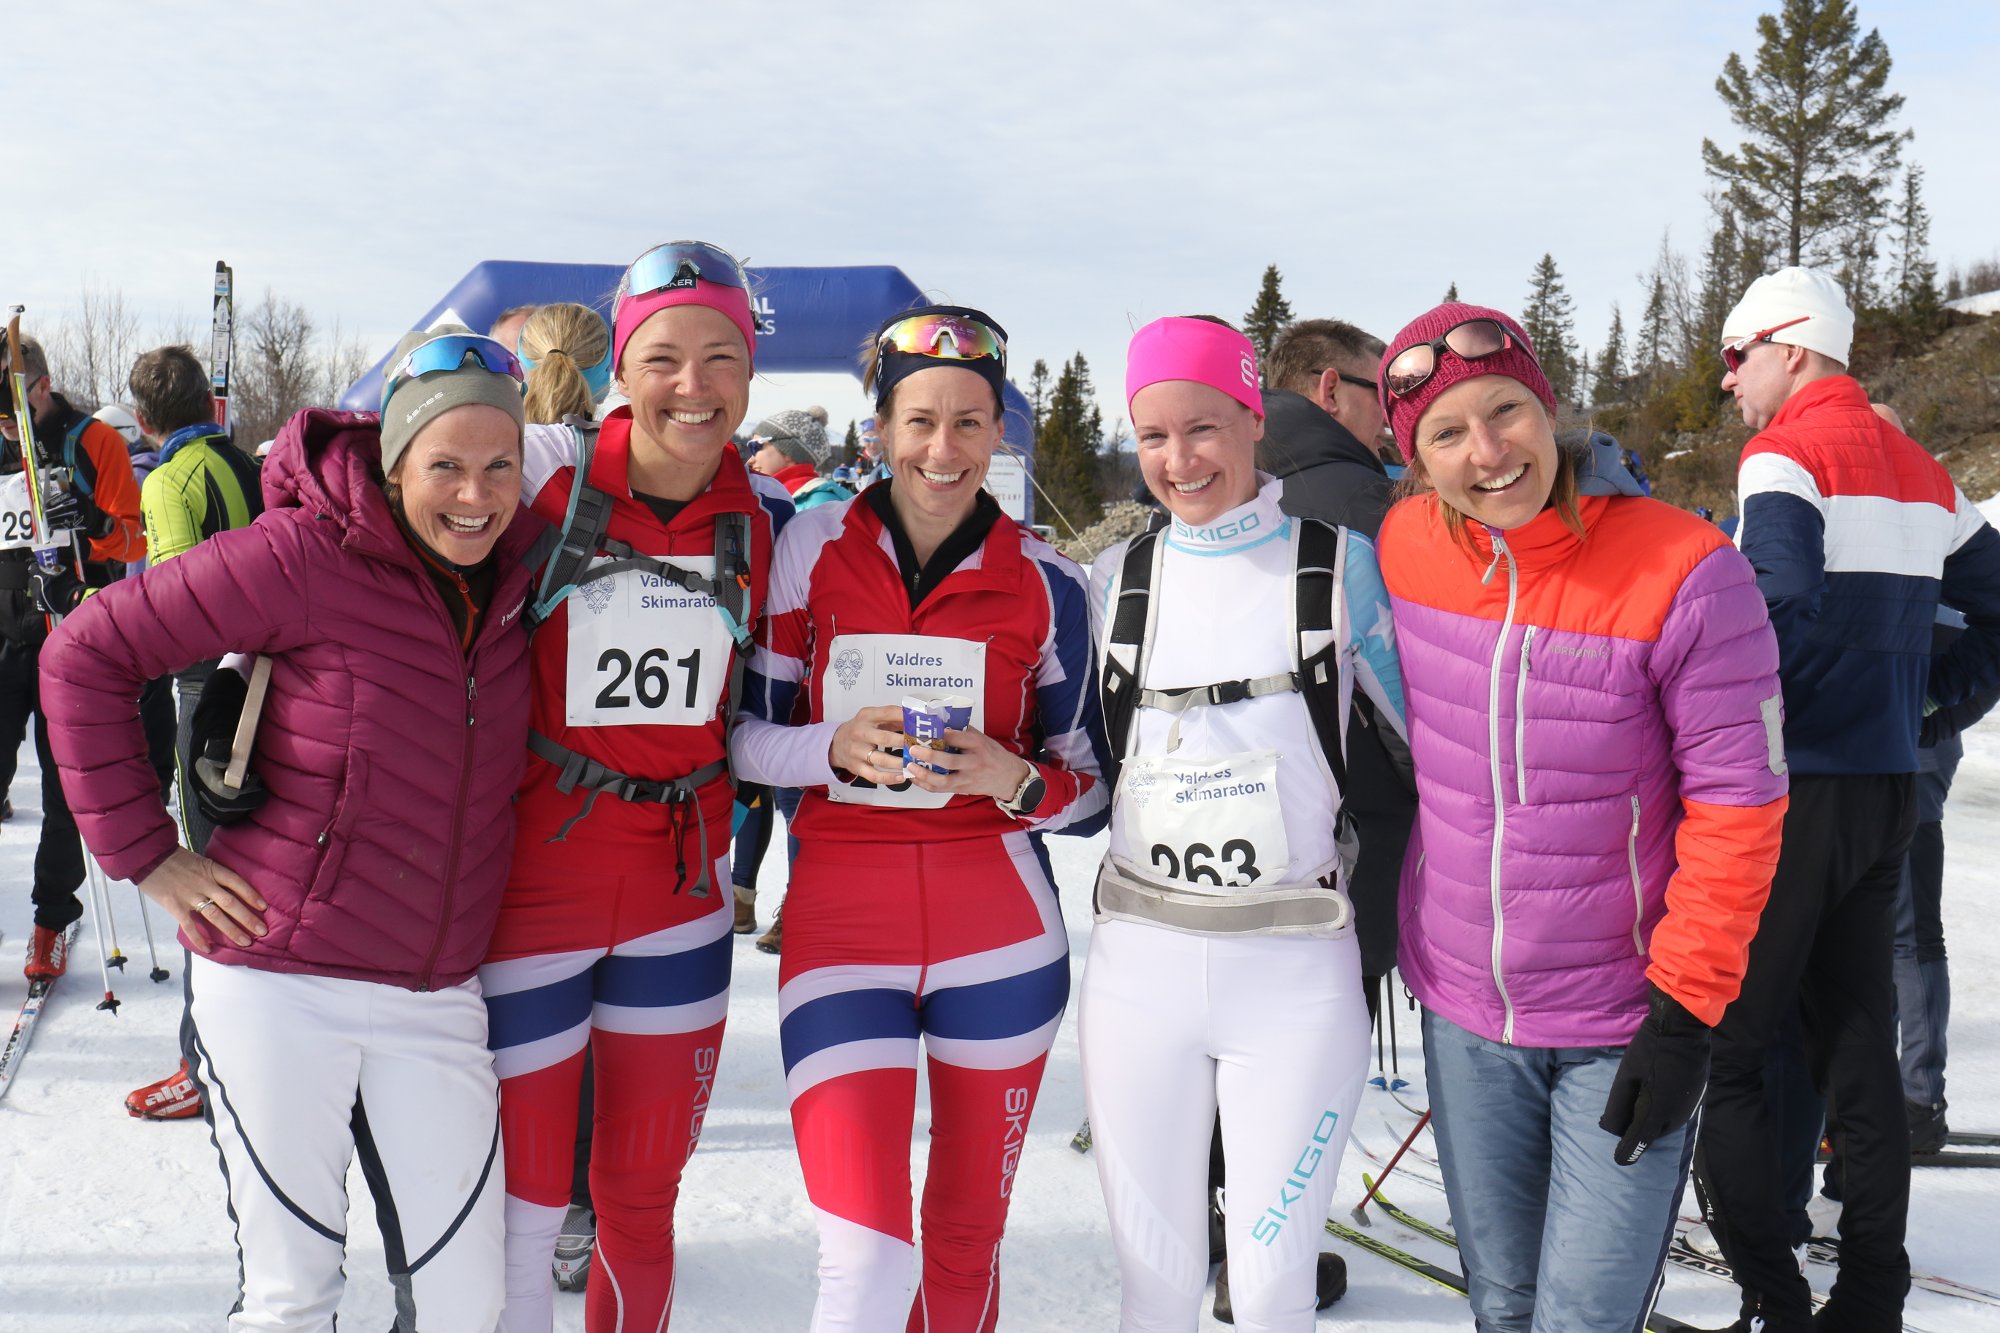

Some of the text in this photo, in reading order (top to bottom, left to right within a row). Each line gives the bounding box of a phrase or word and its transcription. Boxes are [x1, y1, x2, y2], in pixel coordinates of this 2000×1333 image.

[1175, 511, 1261, 542] SKIGO
[641, 595, 717, 609] Skimarato
[886, 652, 943, 667] Valdres
[595, 647, 701, 709] 261
[886, 673, 974, 688] Skimaraton
[1175, 782, 1266, 804] Skimaraton
[1000, 1088, 1029, 1199] SKIGO
[1251, 1110, 1339, 1247] SKIGO
